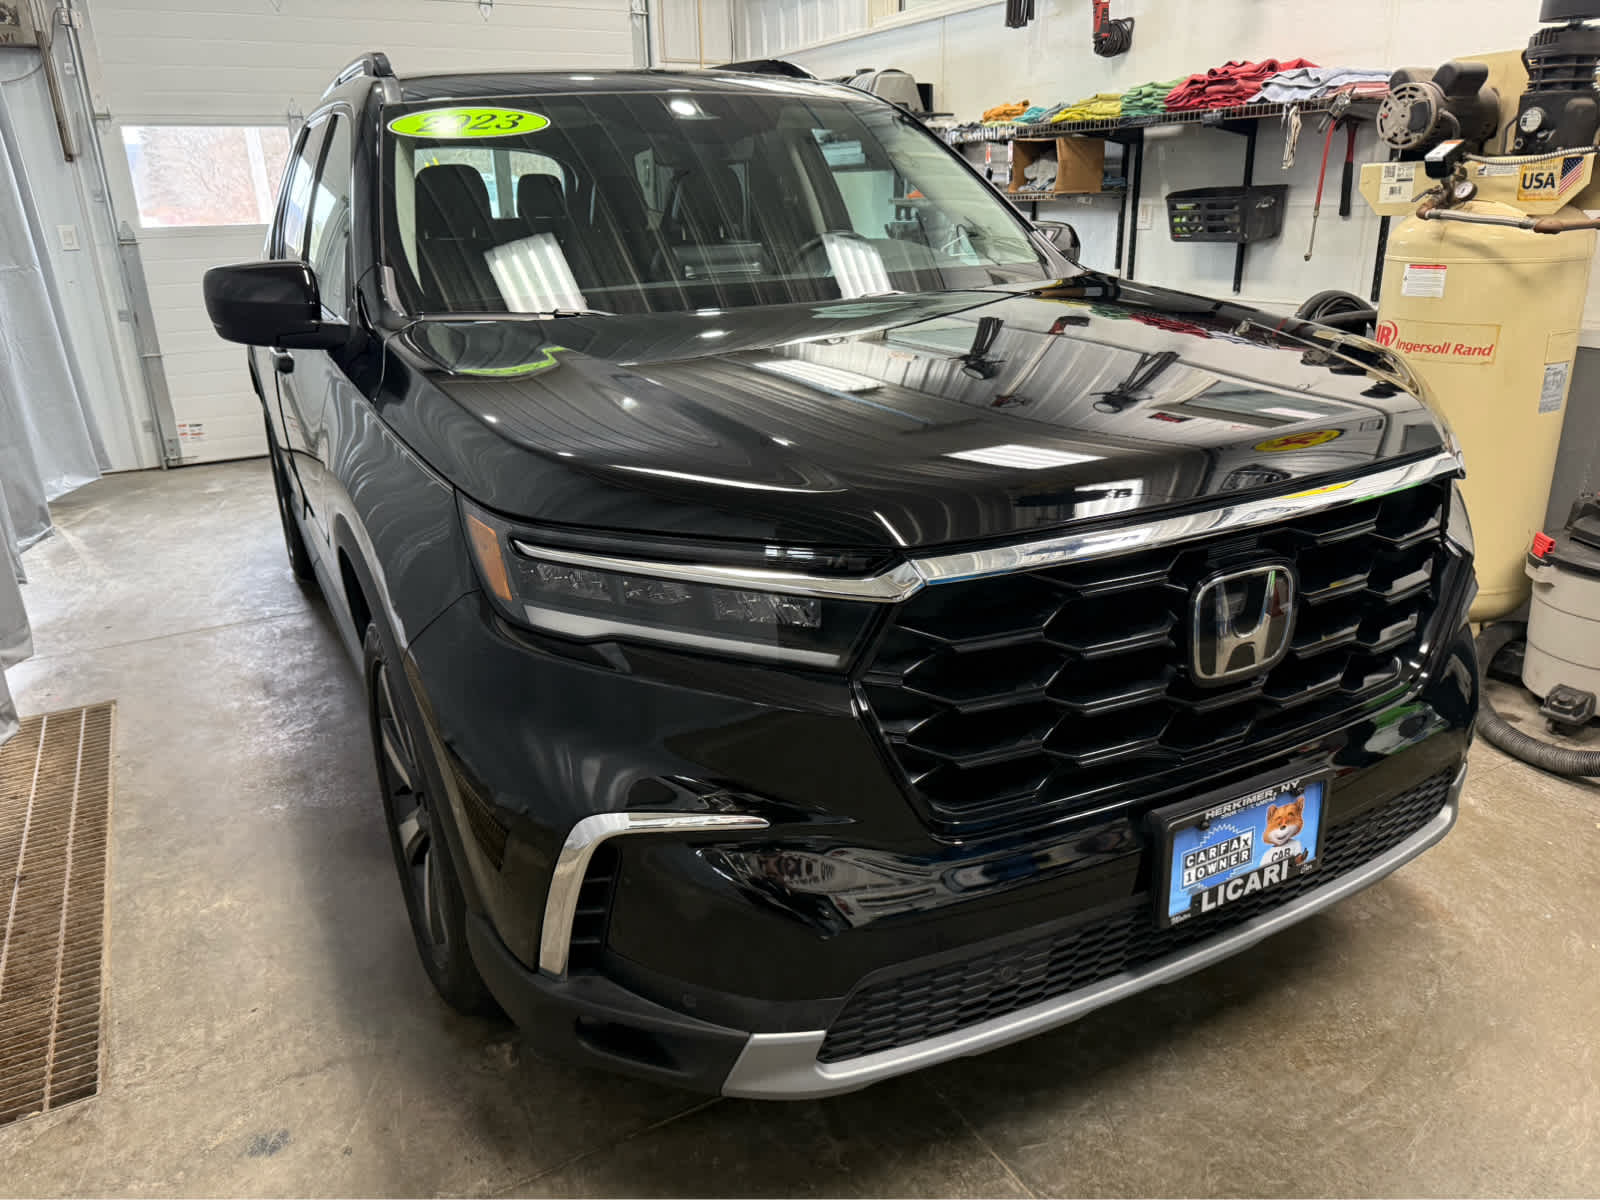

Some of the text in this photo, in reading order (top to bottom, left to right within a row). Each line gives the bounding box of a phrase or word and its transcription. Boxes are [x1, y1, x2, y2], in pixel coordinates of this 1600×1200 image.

[1521, 172, 1555, 190] USA
[1396, 338, 1495, 356] Ingersoll Rand
[1281, 780, 1300, 793] NY
[1185, 834, 1253, 868] CARFAX
[1201, 859, 1289, 913] LICARI
